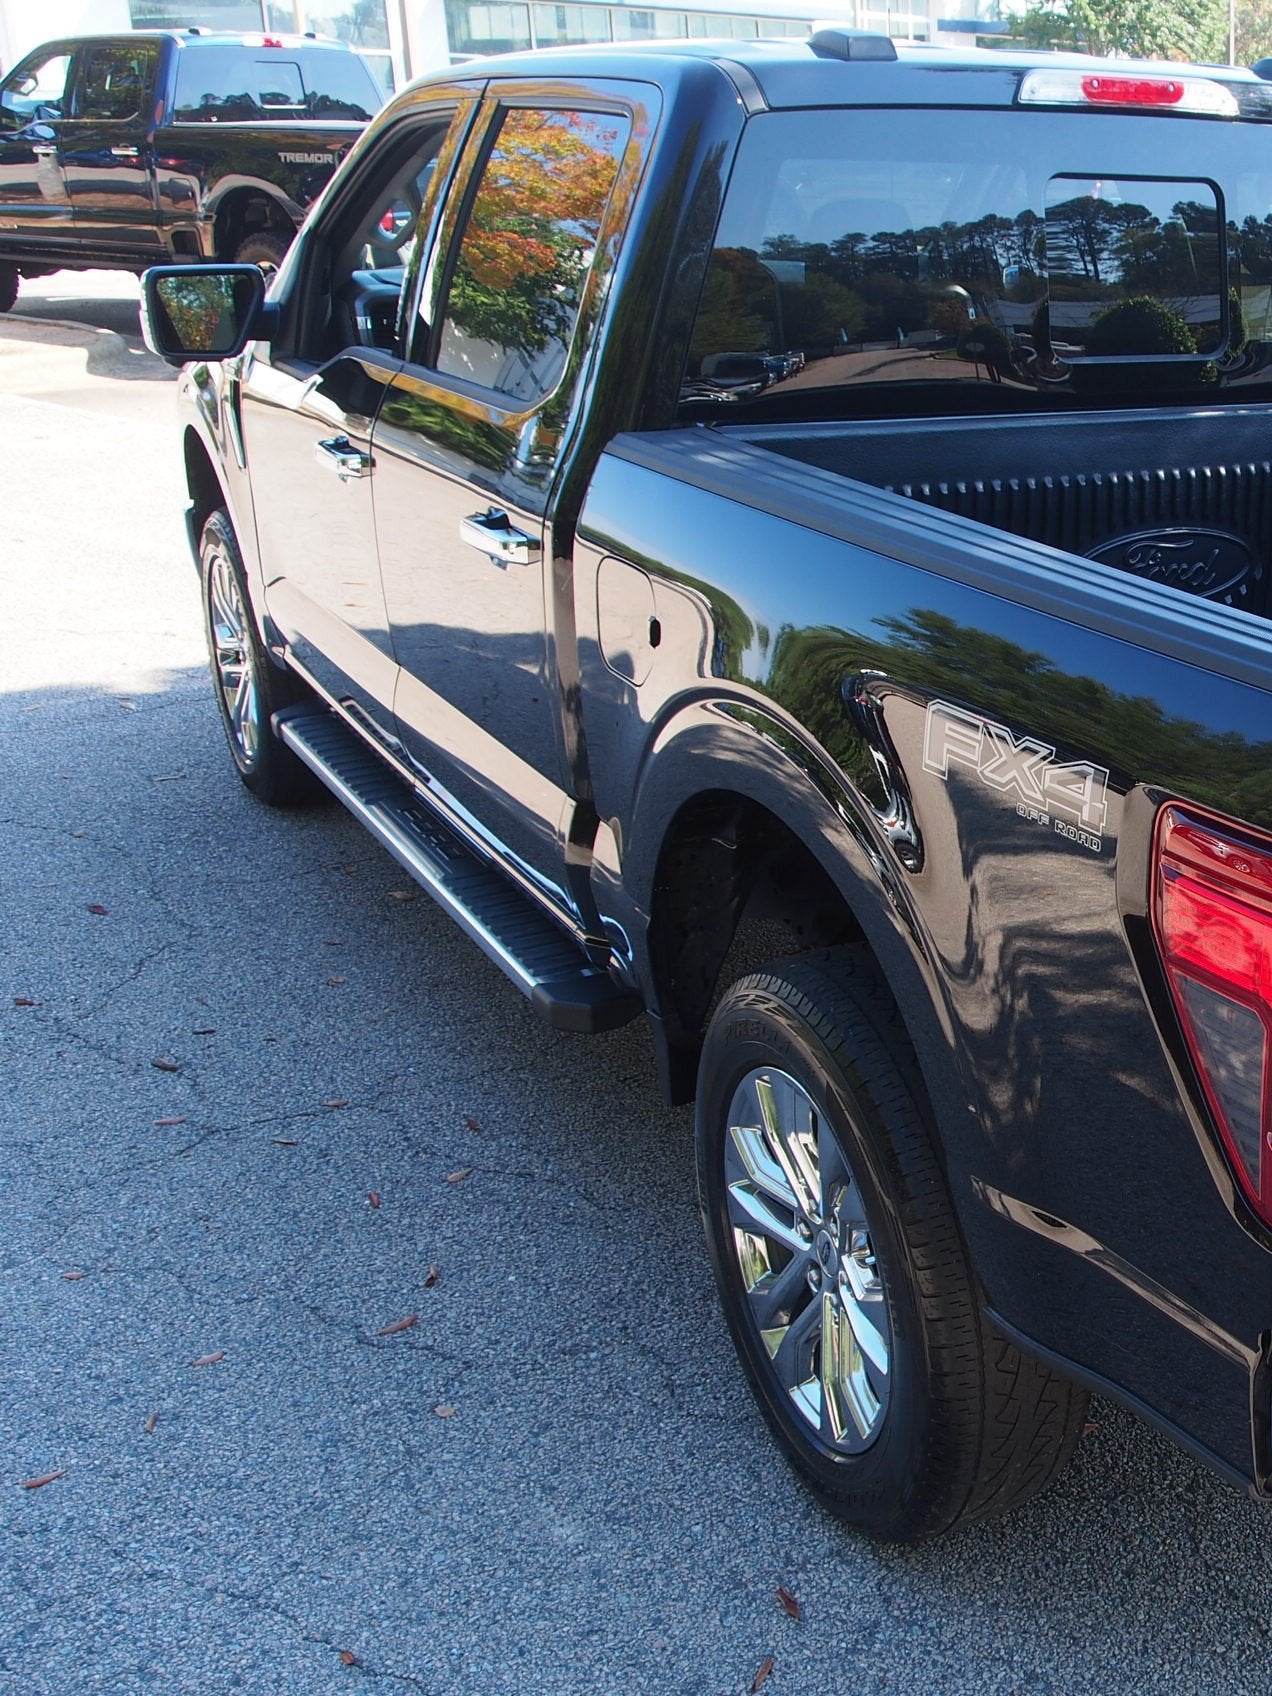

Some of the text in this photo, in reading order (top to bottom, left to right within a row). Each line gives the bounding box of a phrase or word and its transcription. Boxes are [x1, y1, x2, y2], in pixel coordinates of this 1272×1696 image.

[278, 152, 334, 164] TREMOR
[922, 699, 1110, 836] FX4
[1016, 803, 1102, 852] OFF ROAD
